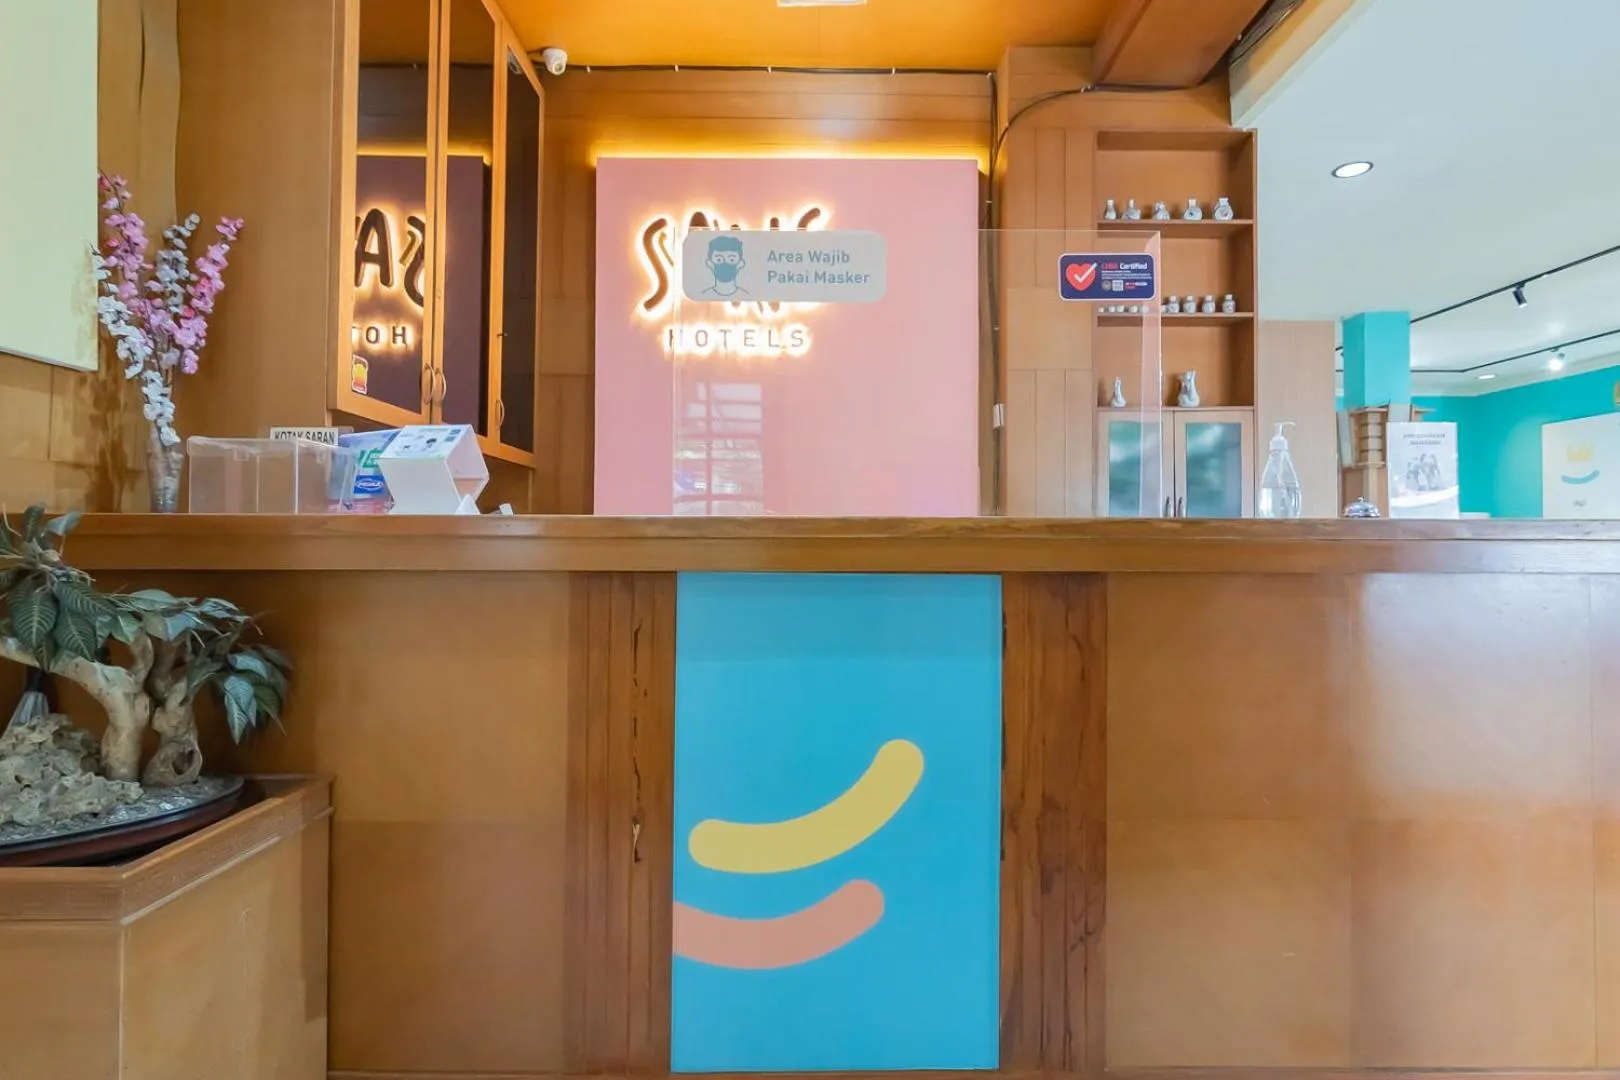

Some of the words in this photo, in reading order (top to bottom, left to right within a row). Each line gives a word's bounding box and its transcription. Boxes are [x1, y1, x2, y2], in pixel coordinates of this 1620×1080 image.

[767, 251, 803, 264] Area
[808, 250, 850, 267] Wajib
[1119, 262, 1148, 270] Certified
[767, 270, 809, 284] Pakai
[814, 270, 870, 284] Masker
[668, 328, 805, 349] HOTELS
